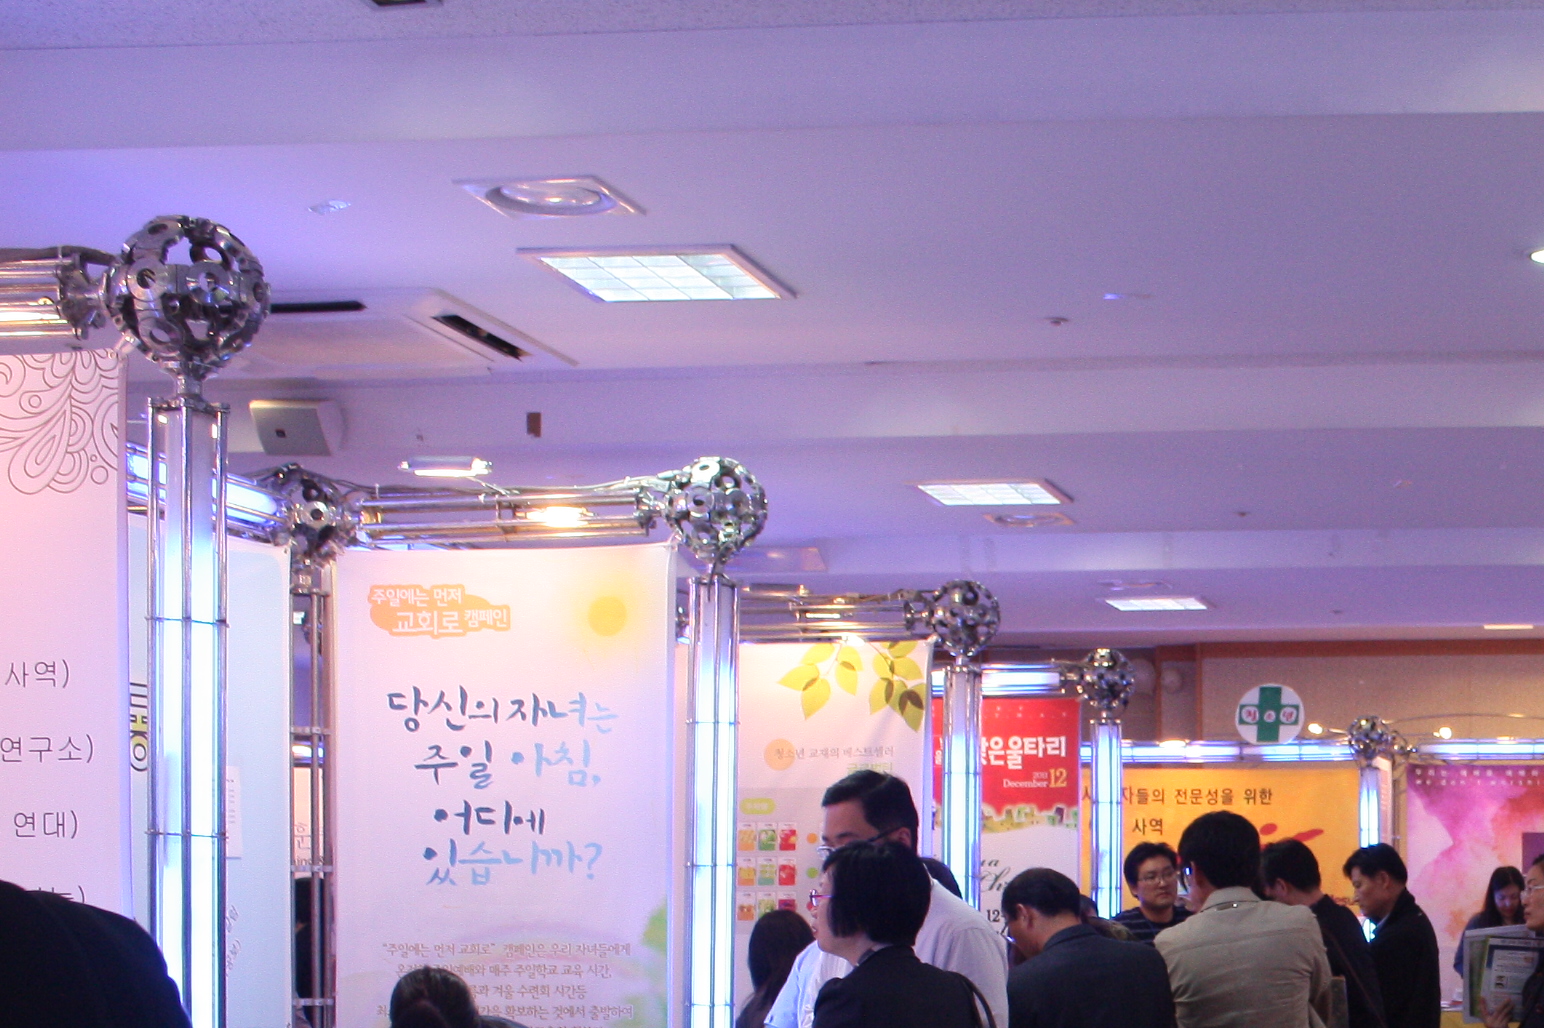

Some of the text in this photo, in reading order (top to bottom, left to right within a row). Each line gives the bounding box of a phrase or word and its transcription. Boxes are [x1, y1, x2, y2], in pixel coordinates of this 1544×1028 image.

[371, 588, 462, 605] 주일에는 먼저
[393, 608, 508, 634] 교회로 캠페인
[386, 685, 620, 735] 당신의 자녀는
[414, 739, 602, 789] 주일 아침,
[1003, 778, 1049, 788] December
[1174, 787, 1235, 806] 전문성을
[1244, 787, 1274, 806] 위한
[433, 800, 546, 836] 어디에
[1132, 818, 1164, 836] 사역
[423, 838, 603, 886] 있습니까?
